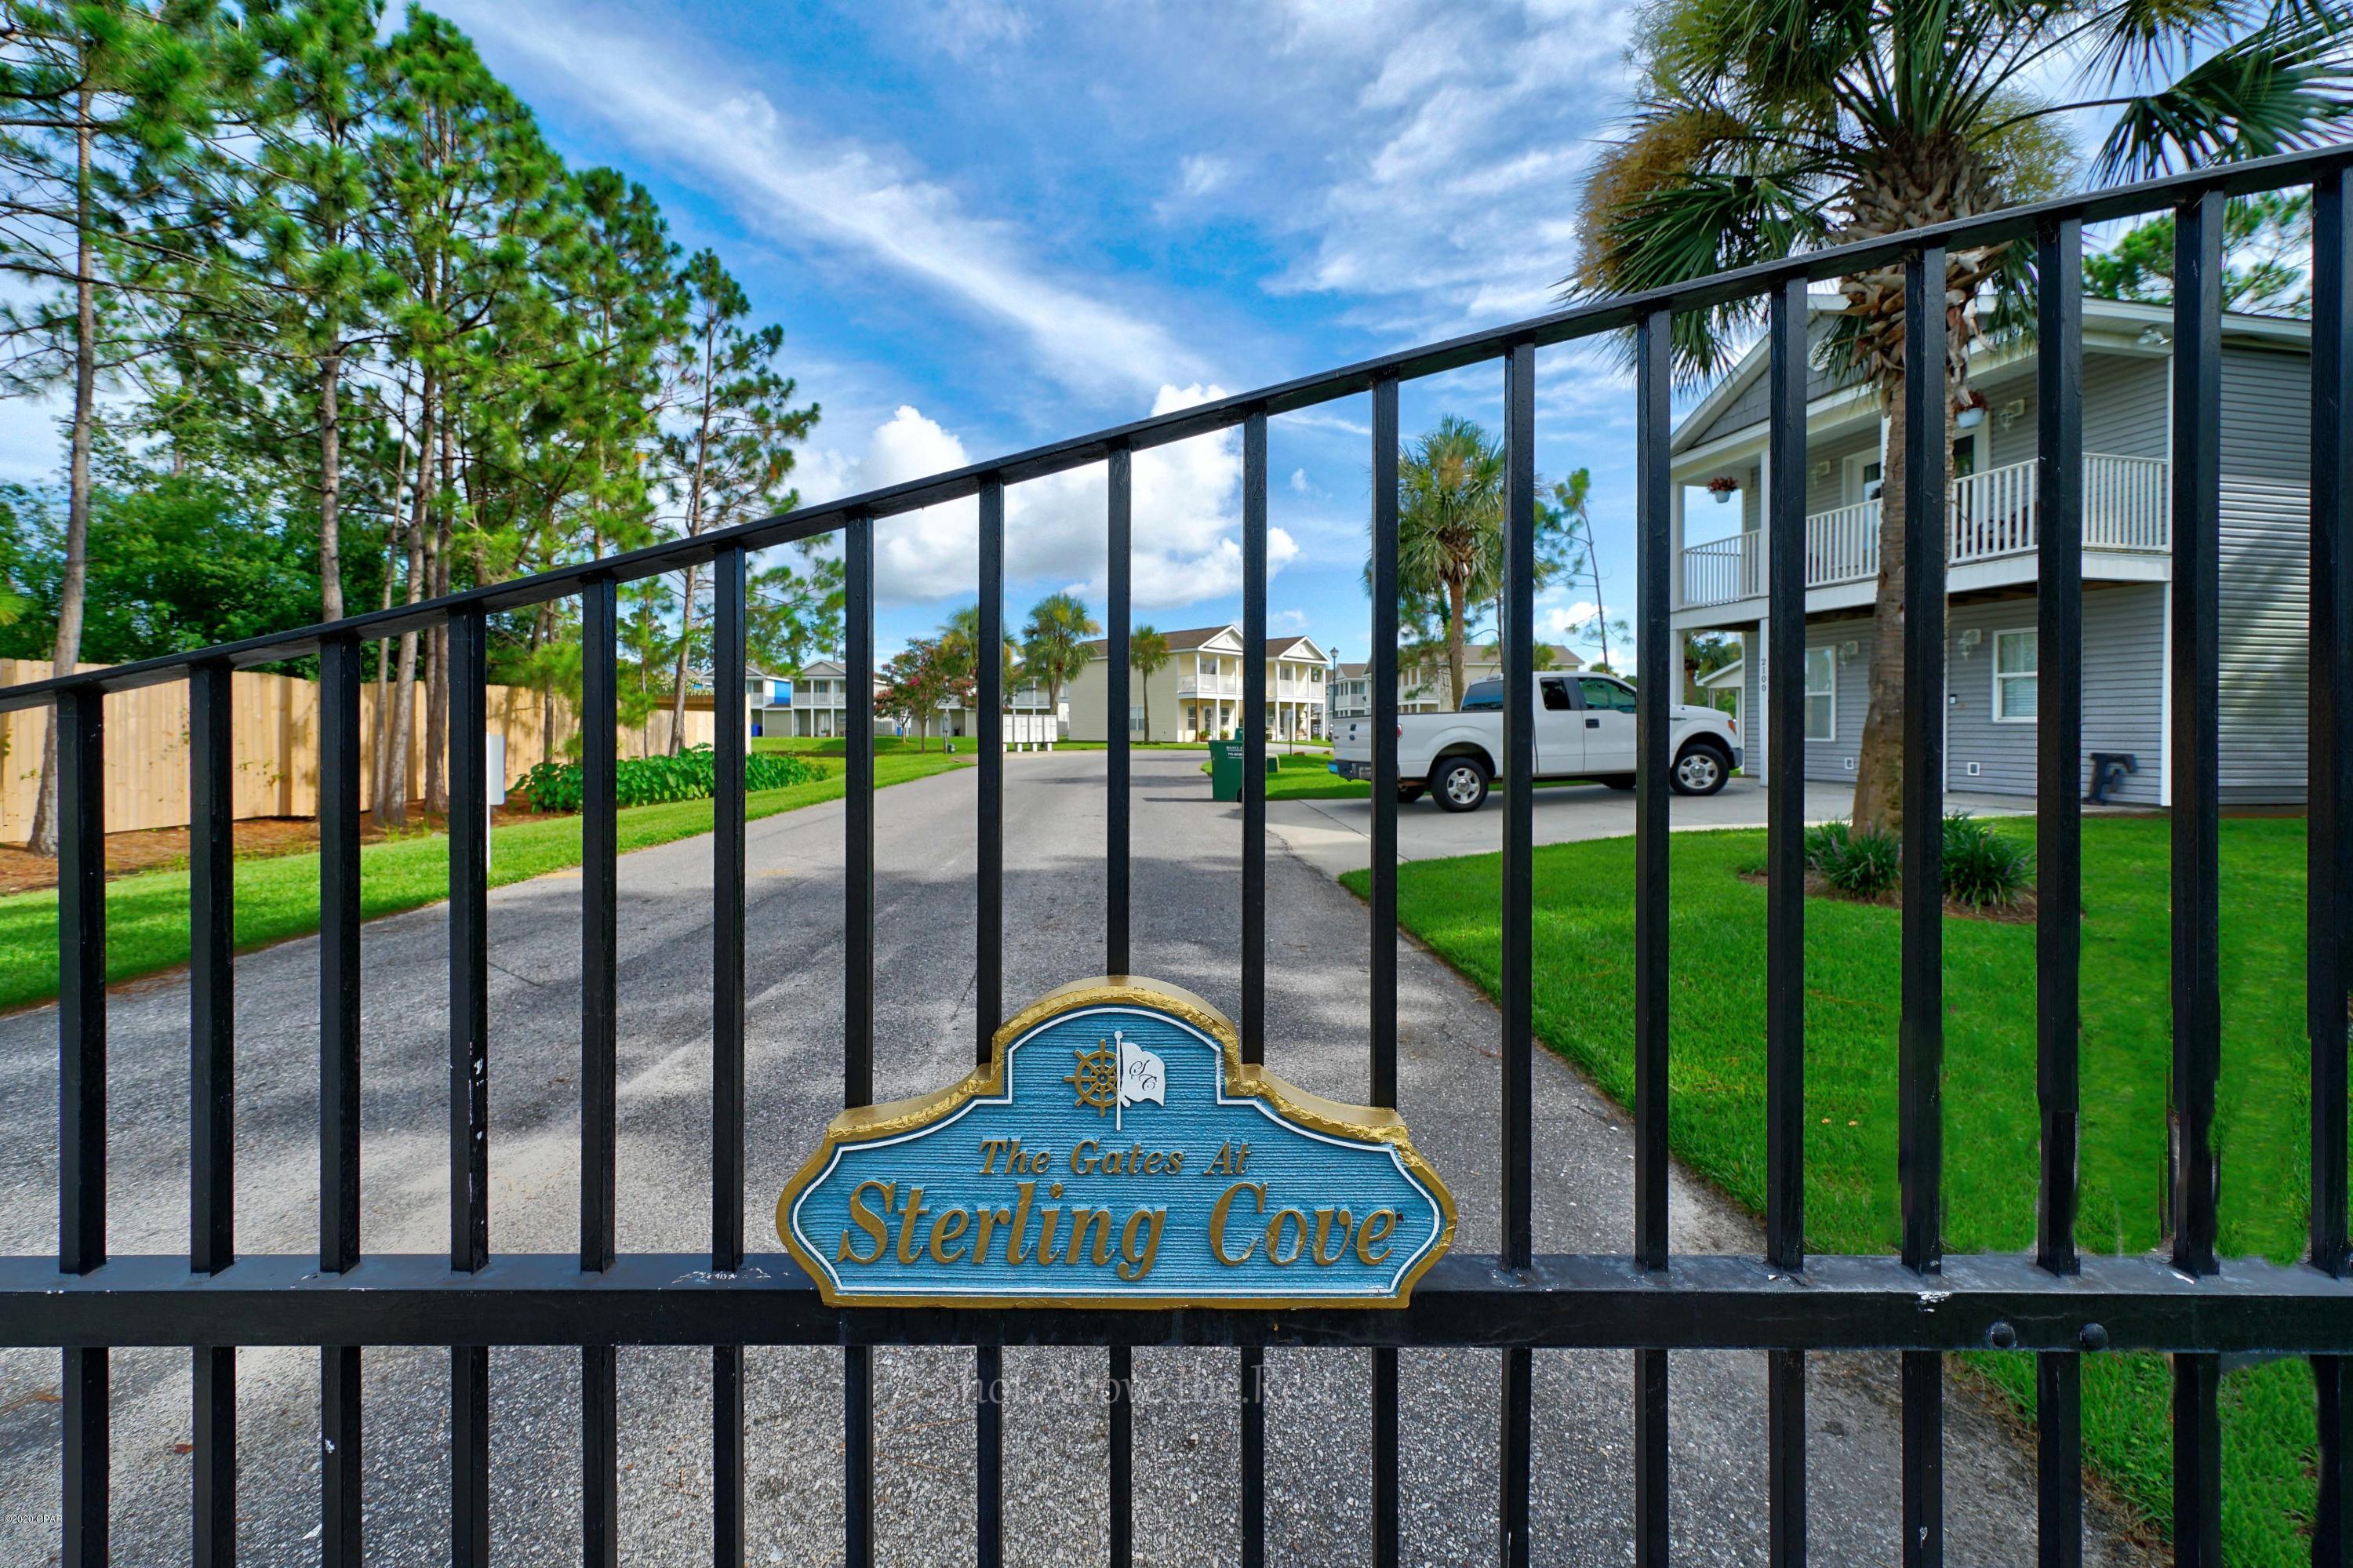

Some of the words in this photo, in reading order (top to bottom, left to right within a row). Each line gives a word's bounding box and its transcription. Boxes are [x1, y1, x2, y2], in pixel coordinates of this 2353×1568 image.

[978, 1139, 1051, 1175] The
[1071, 1139, 1184, 1176] Gates
[1204, 1141, 1252, 1175] At
[836, 1180, 1167, 1281] Sterling
[1209, 1181, 1397, 1266] Cove
